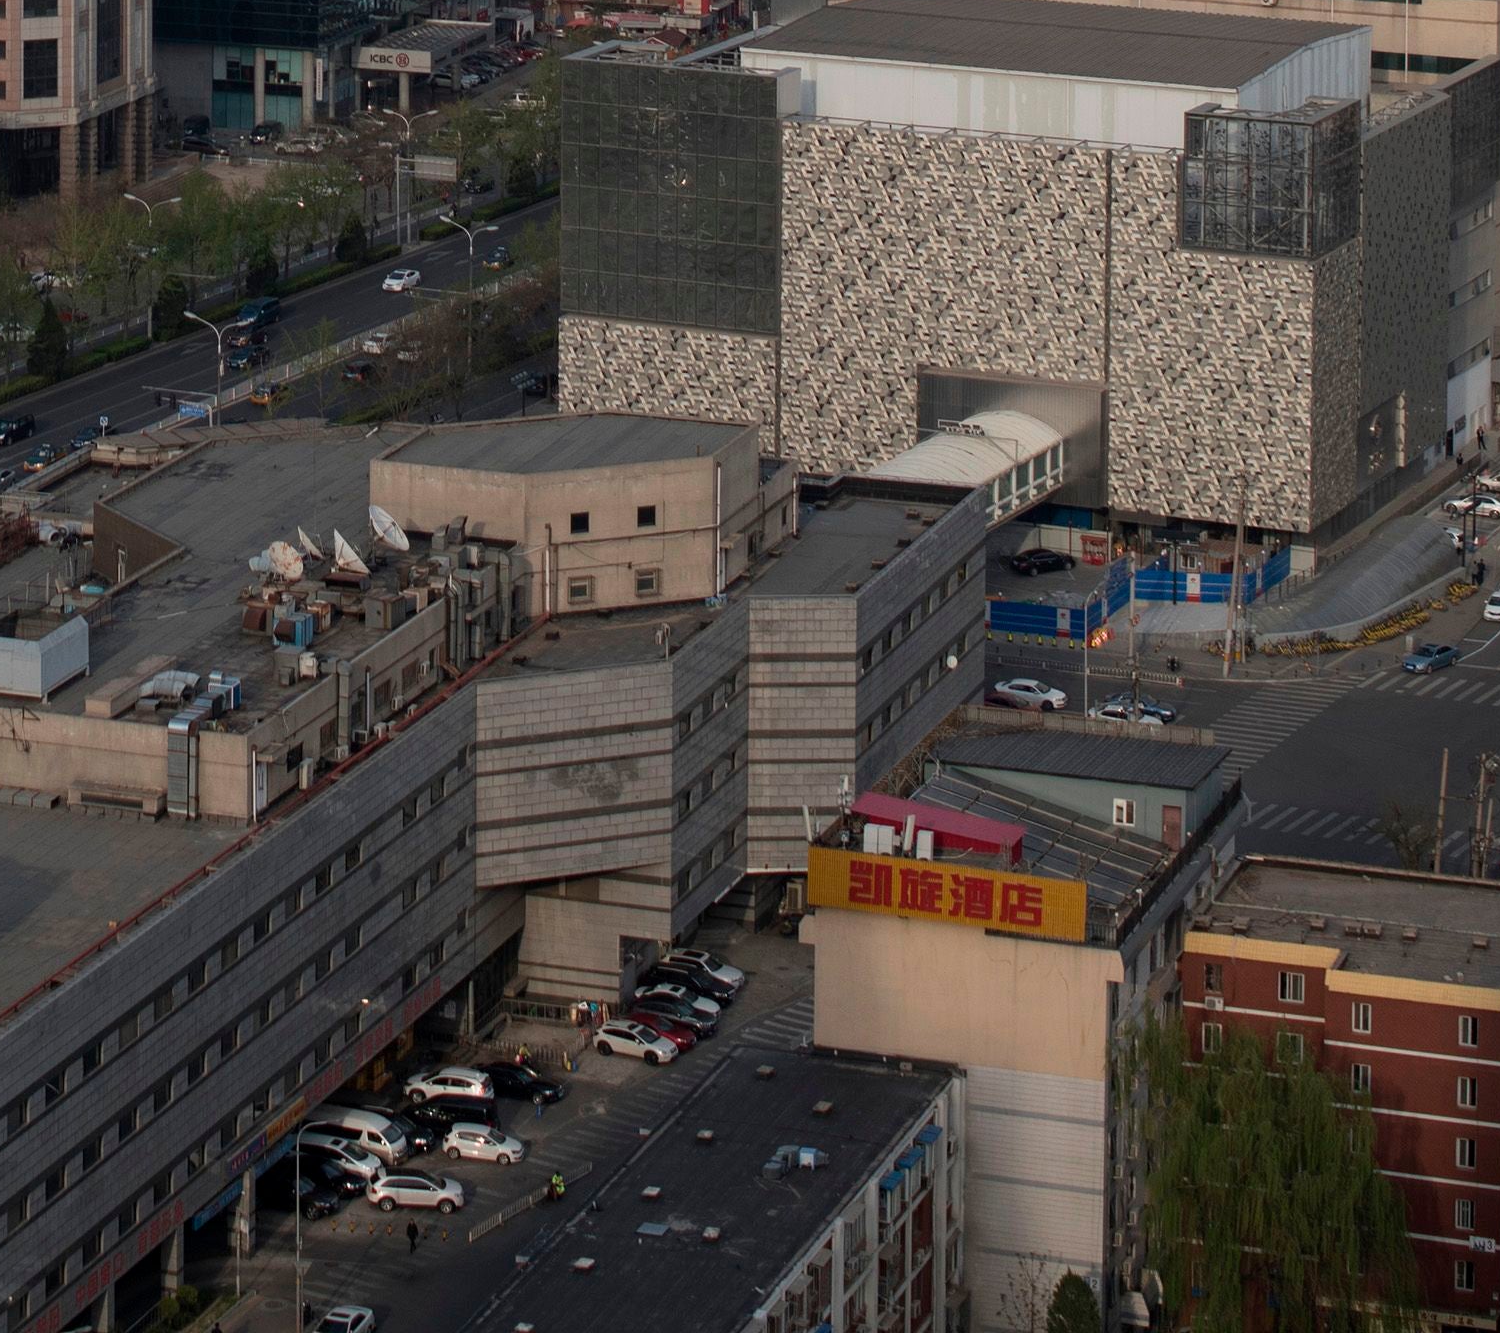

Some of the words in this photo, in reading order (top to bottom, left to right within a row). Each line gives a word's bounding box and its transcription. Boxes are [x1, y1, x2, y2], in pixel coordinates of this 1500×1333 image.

[370, 53, 393, 64] ICBC
[847, 860, 1043, 927] 凯旋酒店
